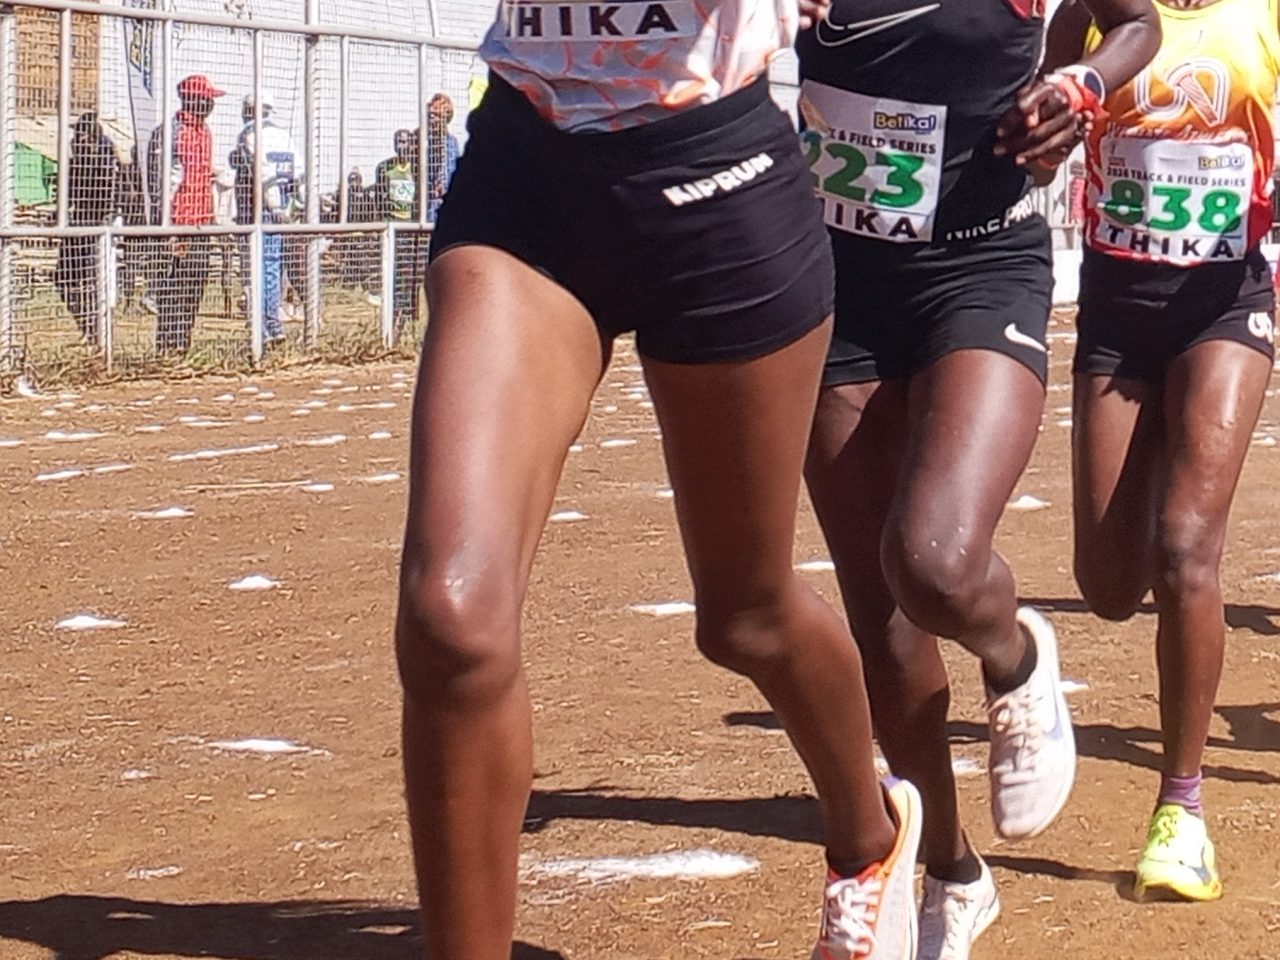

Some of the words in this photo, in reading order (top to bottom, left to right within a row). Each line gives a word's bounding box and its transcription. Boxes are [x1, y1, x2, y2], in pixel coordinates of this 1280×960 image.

[889, 139, 936, 155] SERIES
[662, 152, 774, 206] KIPRUN
[1178, 174, 1208, 186] FIELD
[1211, 177, 1246, 187] SERIES
[820, 198, 918, 239] IKA
[1103, 180, 1241, 233] 838
[1108, 225, 1236, 258] THIKA
